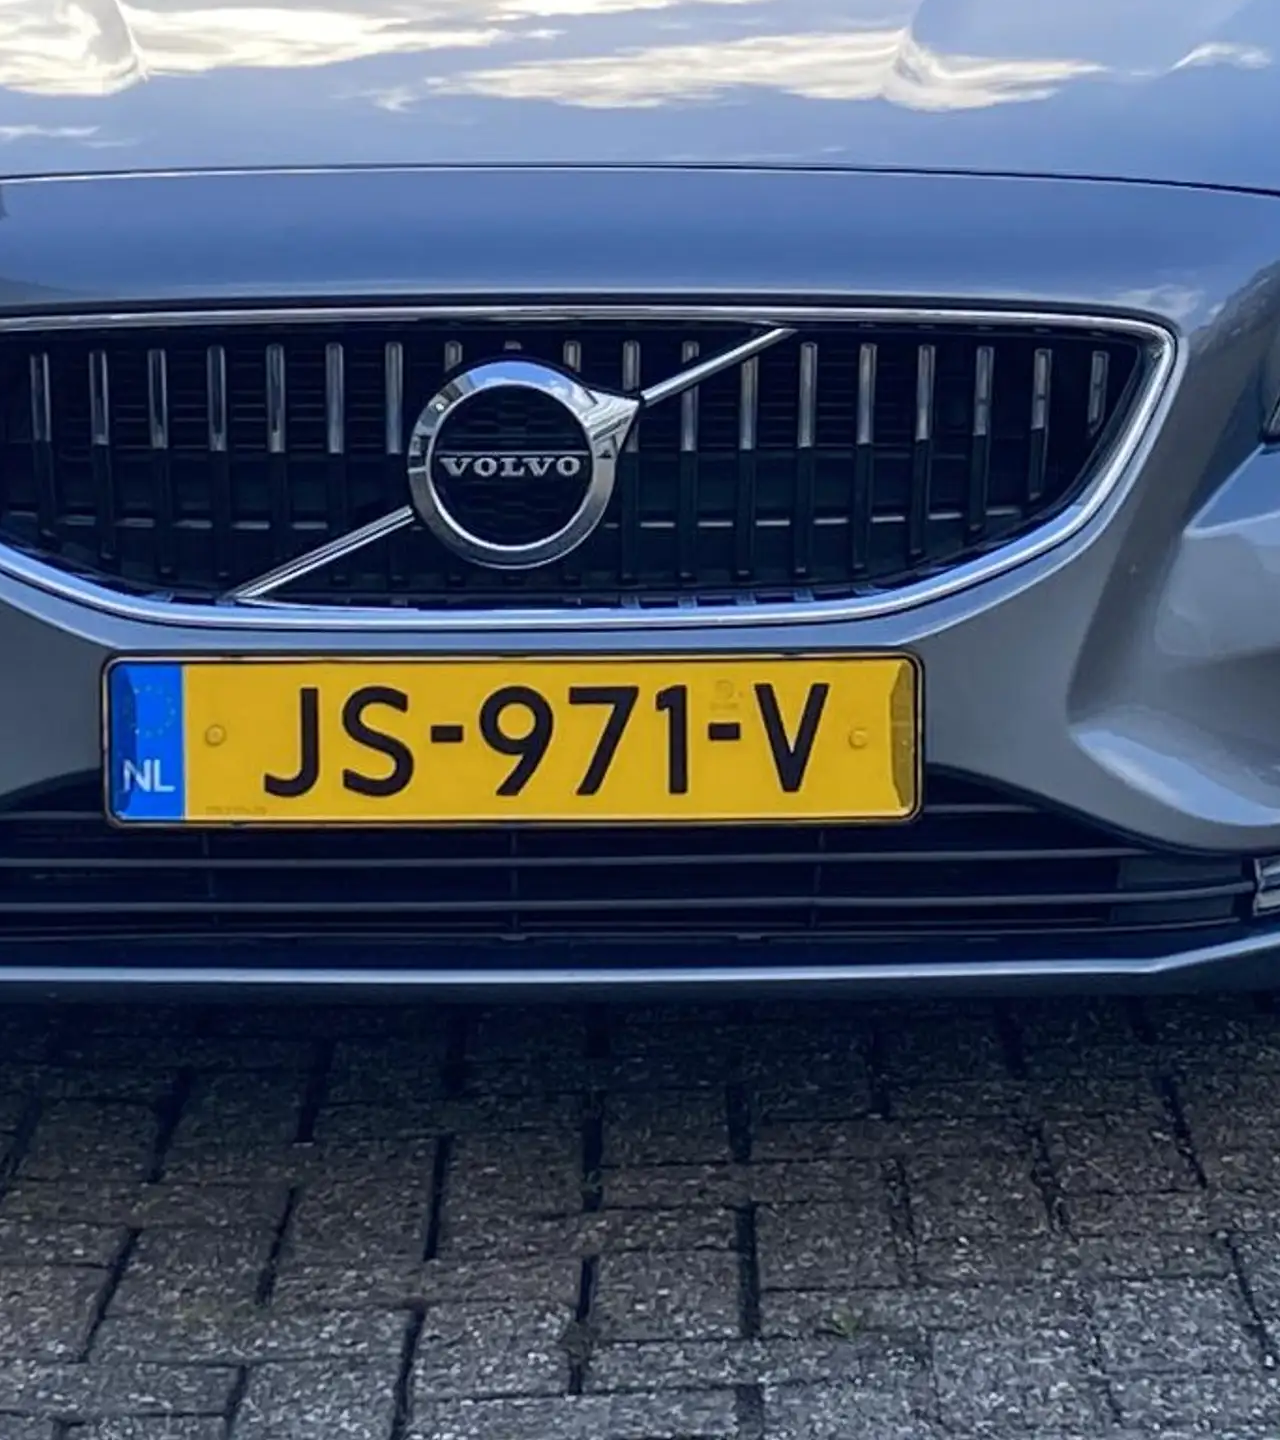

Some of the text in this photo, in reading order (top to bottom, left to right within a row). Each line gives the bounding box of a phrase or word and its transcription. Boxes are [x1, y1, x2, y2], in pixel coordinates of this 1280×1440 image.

[439, 456, 581, 478] VOLVO
[263, 682, 830, 798] JS-971-V
[123, 758, 177, 793] NL
